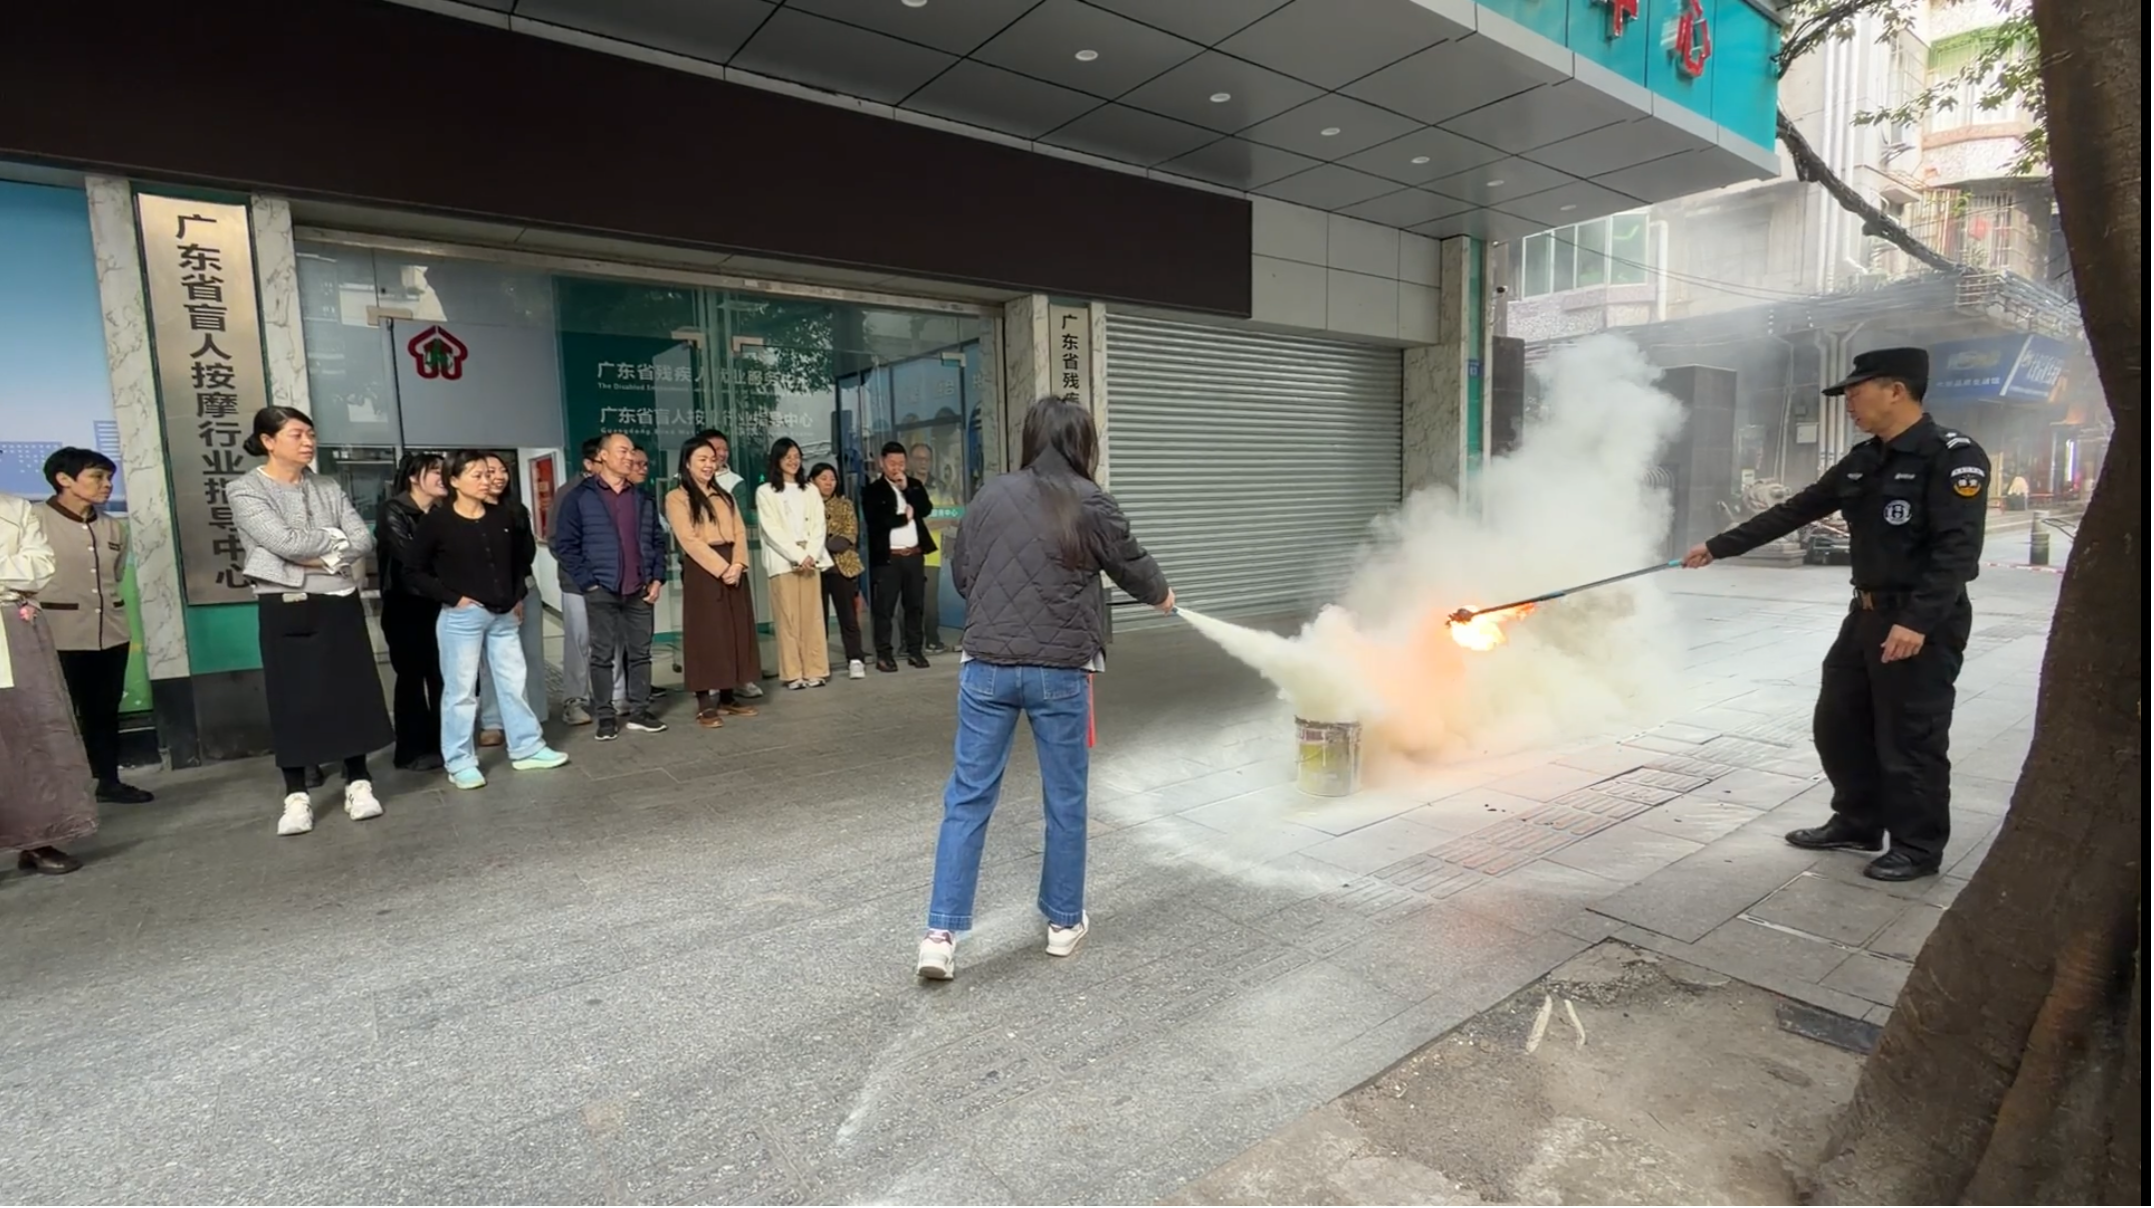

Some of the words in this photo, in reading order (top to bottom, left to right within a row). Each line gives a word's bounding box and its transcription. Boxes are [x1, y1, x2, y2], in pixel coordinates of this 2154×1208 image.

[600, 406, 814, 428] 广东省盲人按行业指导中心
